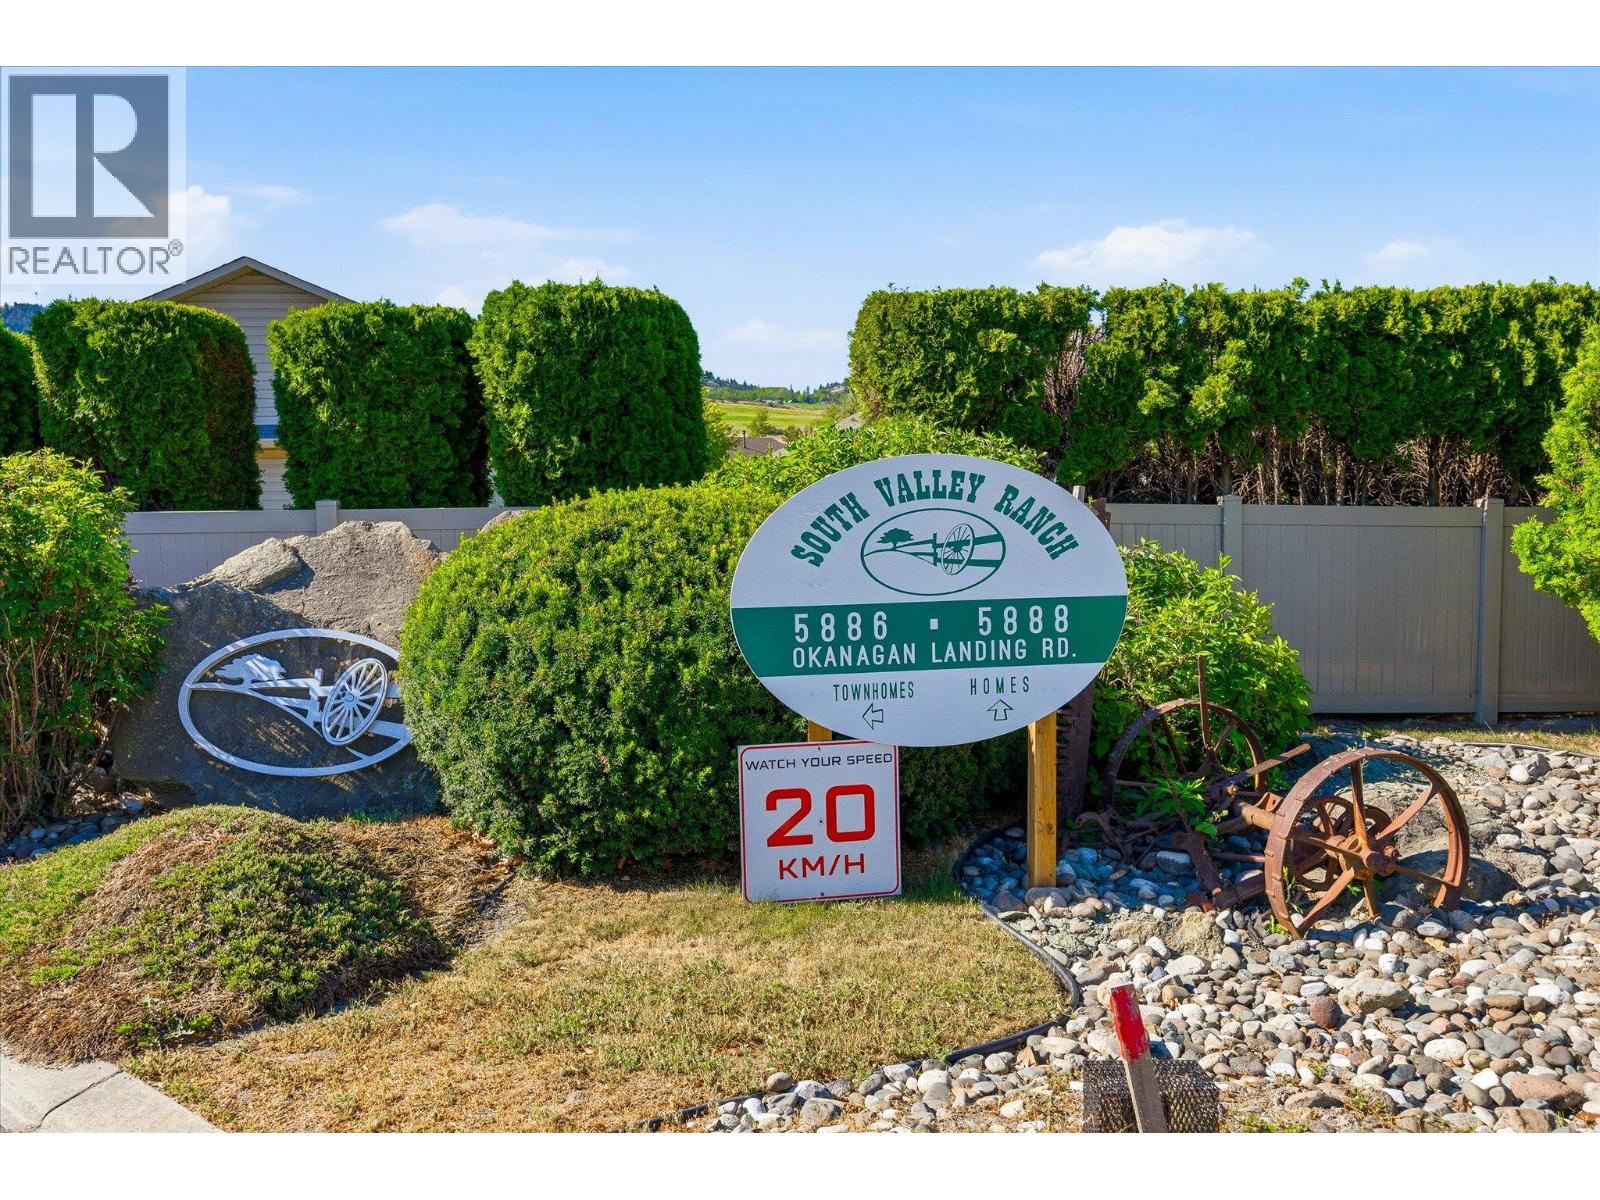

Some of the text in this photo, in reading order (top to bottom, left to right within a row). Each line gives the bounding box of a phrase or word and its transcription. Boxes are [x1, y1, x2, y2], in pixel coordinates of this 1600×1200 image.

[791, 470, 1081, 567] SOUTH VALLEY RANCH
[794, 604, 1069, 642] 5886 5888
[792, 637, 1077, 668] OKANAGAN LANDING RD.
[833, 681, 915, 702] TOWNHOMES
[970, 676, 1030, 695] HOMES
[745, 753, 893, 771] WATCH YOUR SPEED
[766, 784, 876, 847] 20
[778, 853, 865, 880] KM/H
